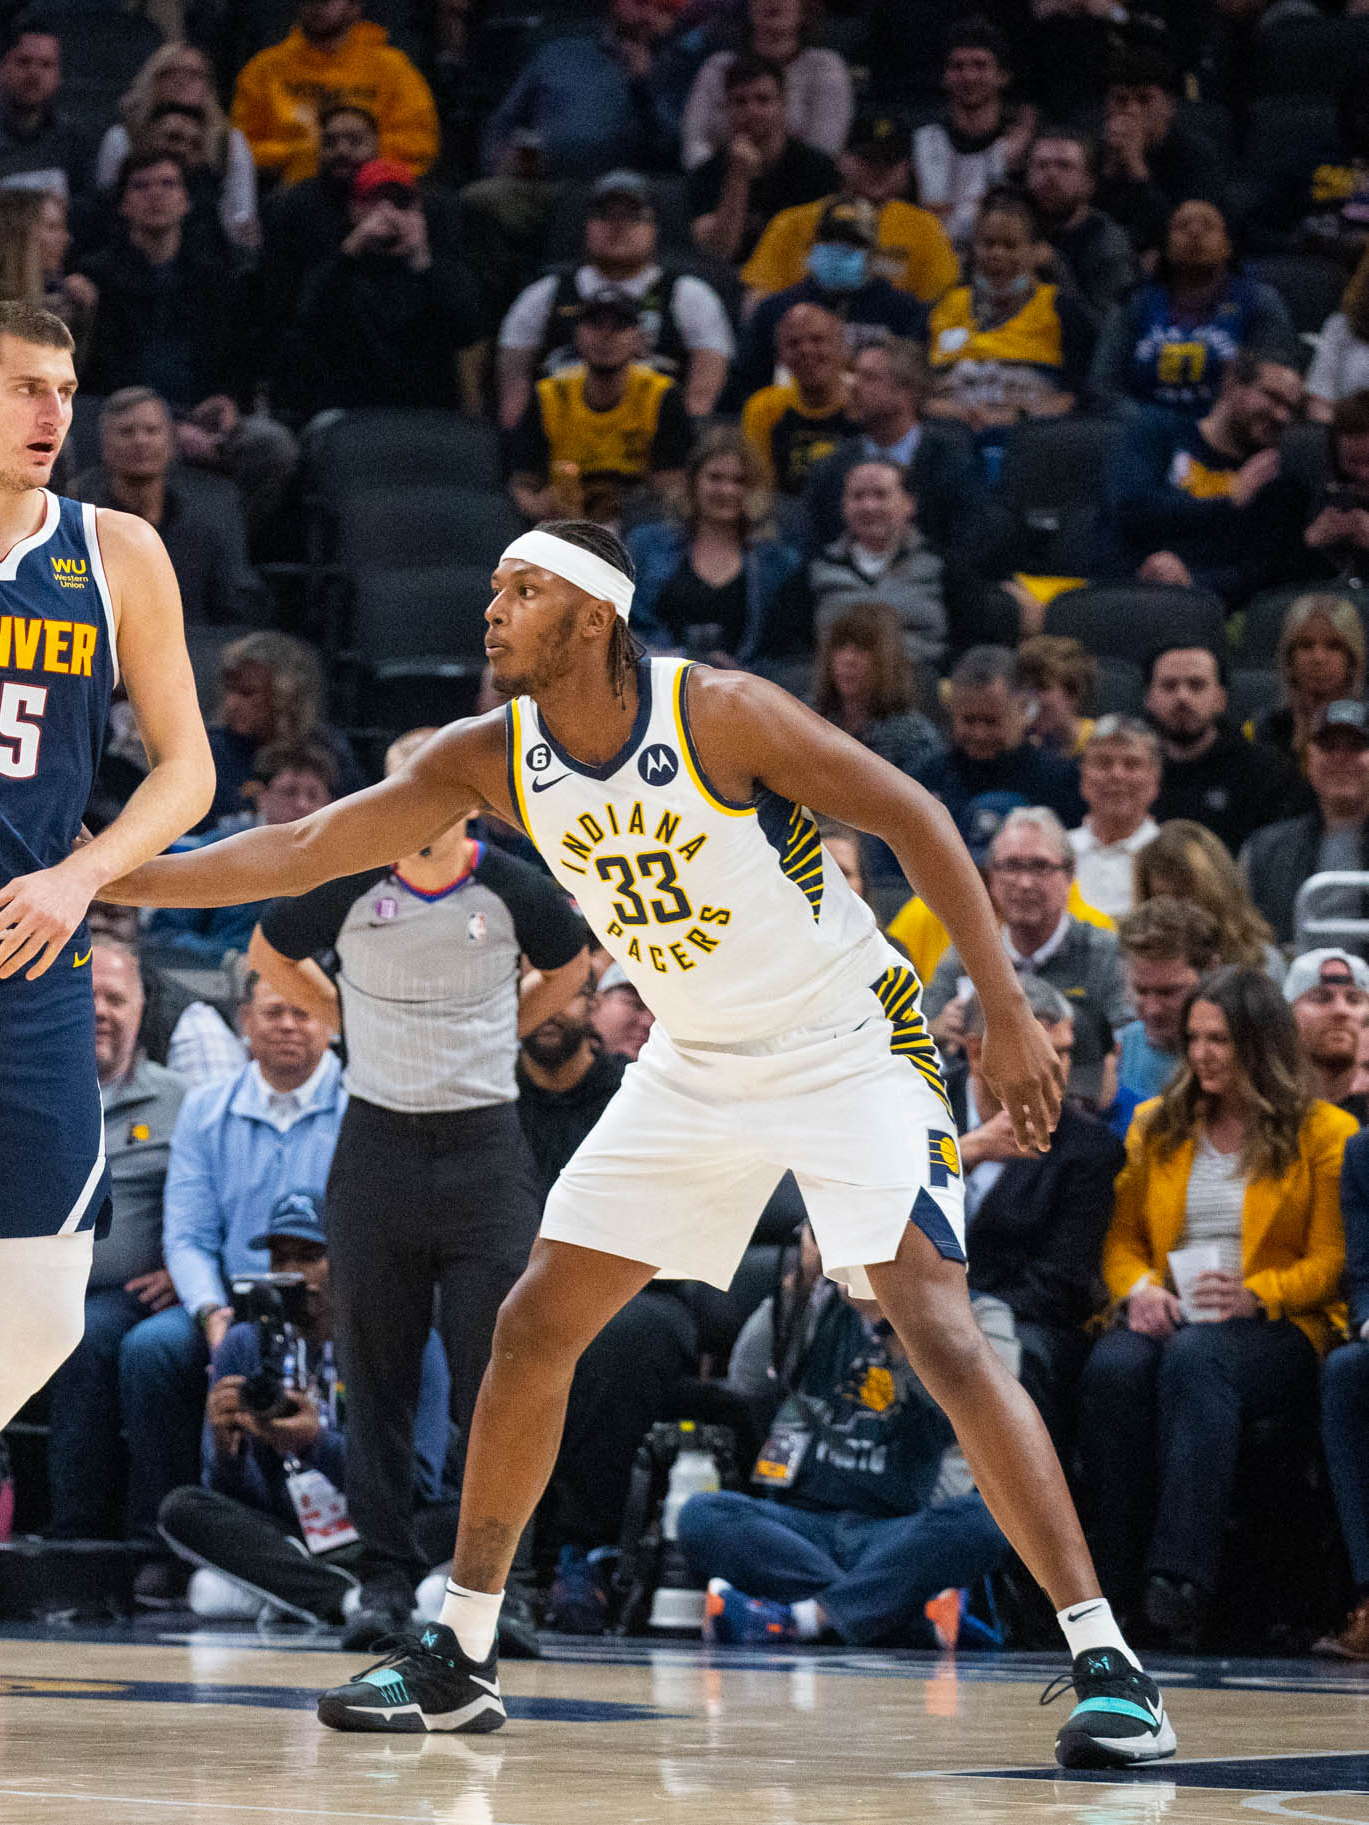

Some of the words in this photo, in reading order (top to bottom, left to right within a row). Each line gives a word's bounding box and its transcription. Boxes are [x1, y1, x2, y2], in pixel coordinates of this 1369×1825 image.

[51, 556, 87, 574] WU
[53, 573, 89, 583] Western
[60, 580, 85, 589] Union
[532, 747, 549, 768] 6
[561, 801, 708, 876] INDIANA
[594, 849, 693, 926] 33
[606, 904, 732, 974] PACERS
